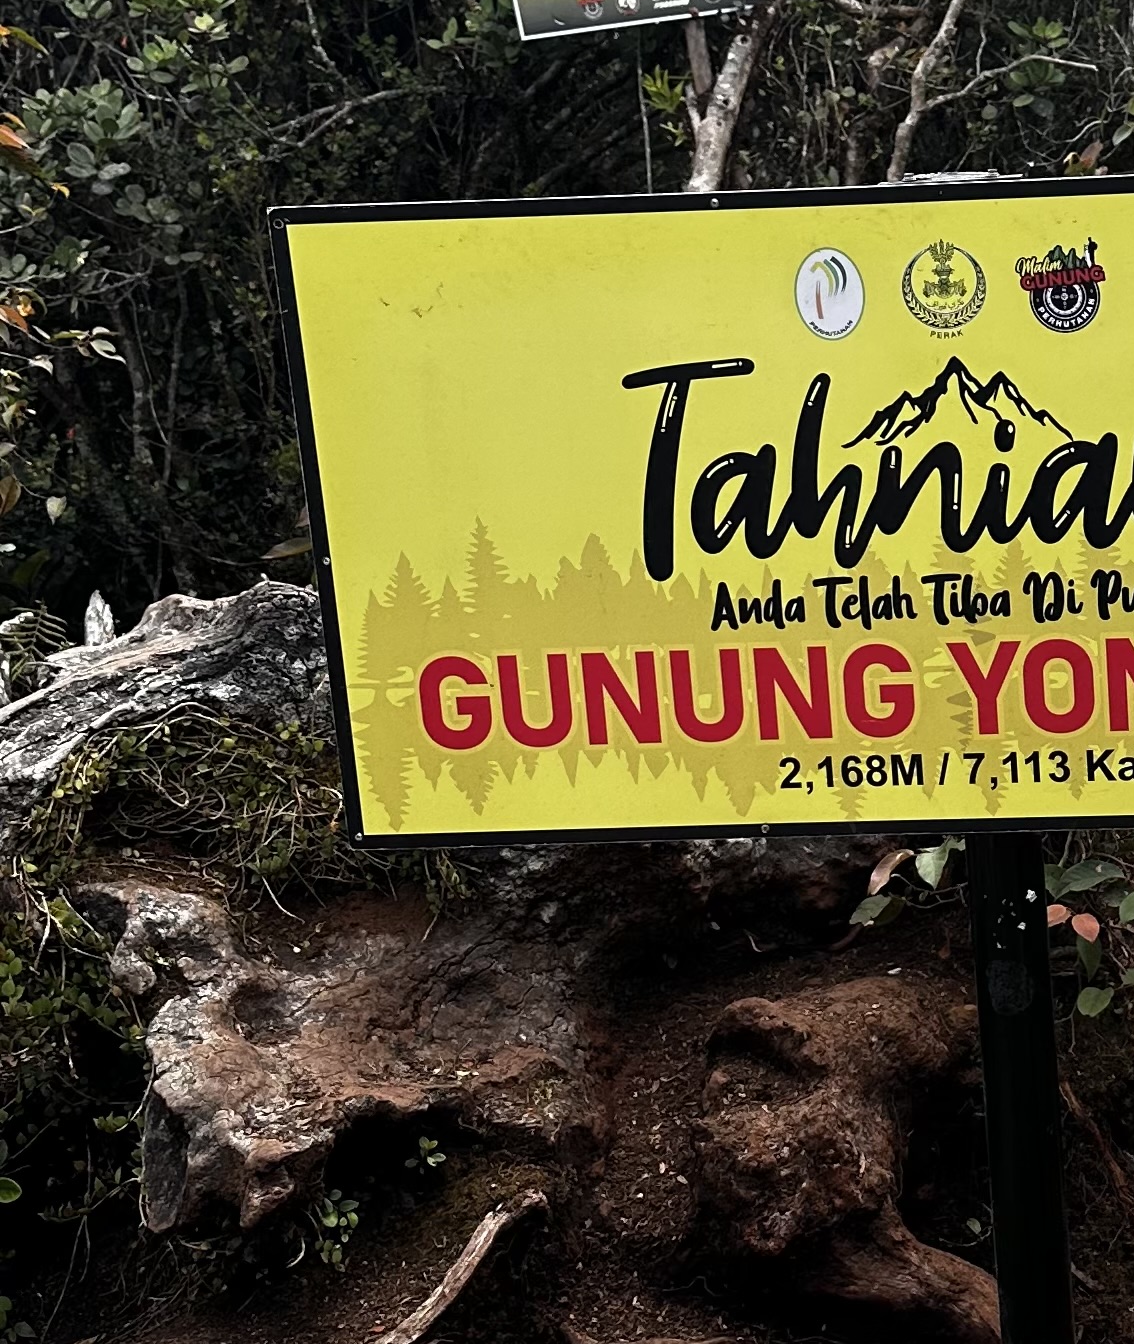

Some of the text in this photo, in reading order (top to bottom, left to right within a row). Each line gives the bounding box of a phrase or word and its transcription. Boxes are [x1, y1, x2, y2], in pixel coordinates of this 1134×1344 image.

[1016, 256, 1063, 277] Malim
[1021, 264, 1106, 290] GUNUNG
[1037, 297, 1097, 329] PERHUTANAN
[930, 329, 964, 339] PERAK
[711, 581, 805, 632] Anda
[812, 575, 917, 630] Telah
[920, 573, 1011, 626] Tiba
[1022, 571, 1083, 623] Di
[419, 643, 916, 751] GUNUNG
[779, 754, 924, 795] 2,168M
[939, 754, 949, 791] /
[963, 751, 1071, 791] 7,113
